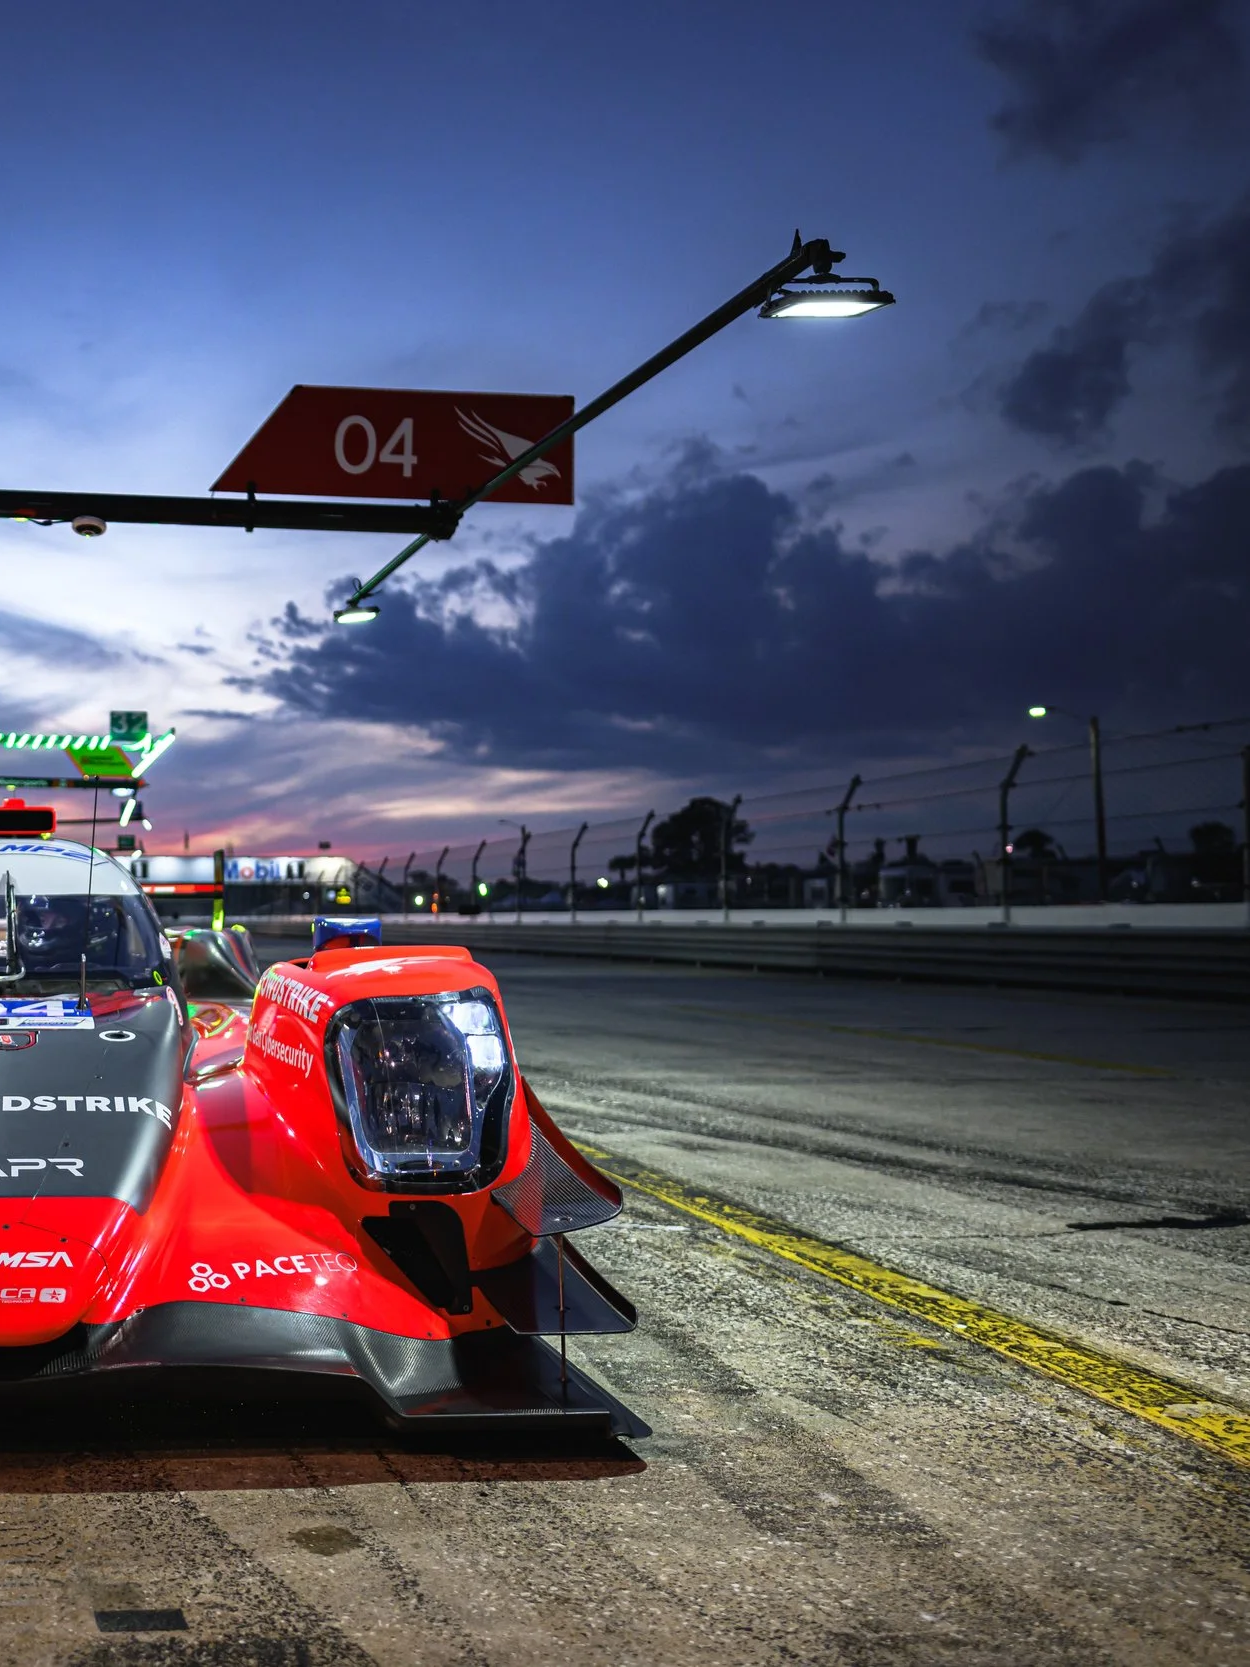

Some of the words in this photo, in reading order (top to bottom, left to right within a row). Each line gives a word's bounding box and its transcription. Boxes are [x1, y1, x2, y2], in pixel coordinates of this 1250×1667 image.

[334, 415, 417, 478] 04
[112, 711, 146, 734] 32
[224, 860, 280, 880] Mobil
[261, 1030, 314, 1079] Cybersecurity
[231, 1252, 358, 1281] PACETEQ
